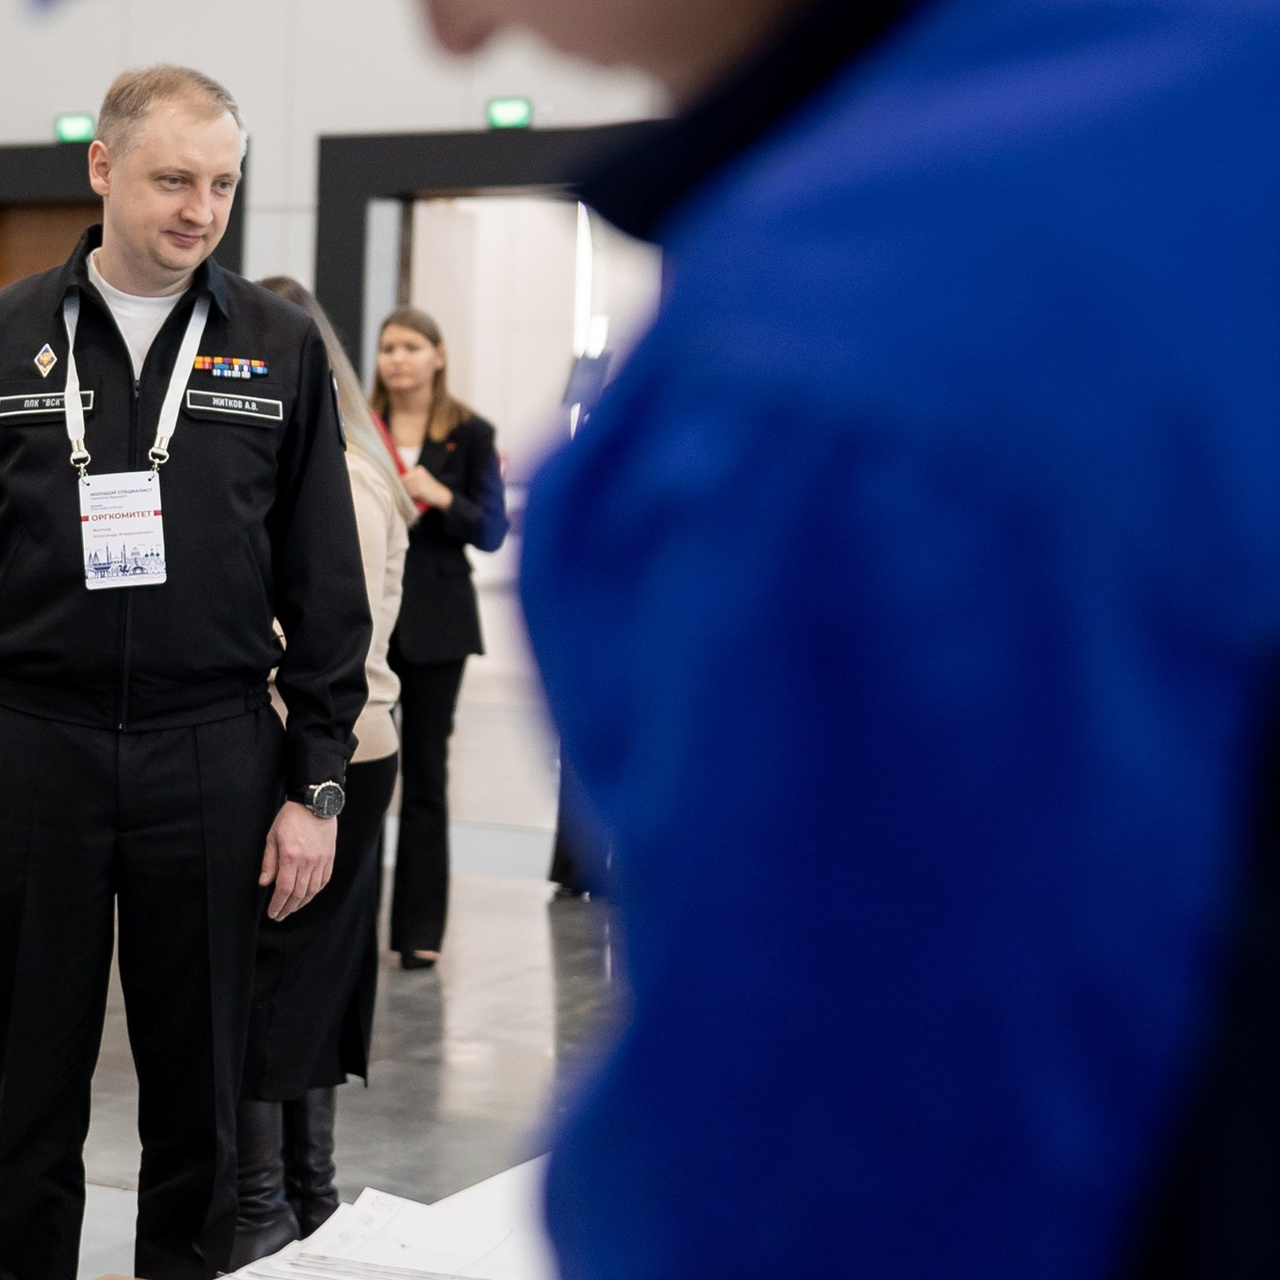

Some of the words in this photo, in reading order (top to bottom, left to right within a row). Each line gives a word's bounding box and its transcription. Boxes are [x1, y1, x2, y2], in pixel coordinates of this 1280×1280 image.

[24, 399, 40, 408] ППК
[212, 397, 243, 409] ЖИТКОВ
[245, 401, 259, 410] А.В.
[92, 510, 152, 521] ОРГКОМИТЕТ
